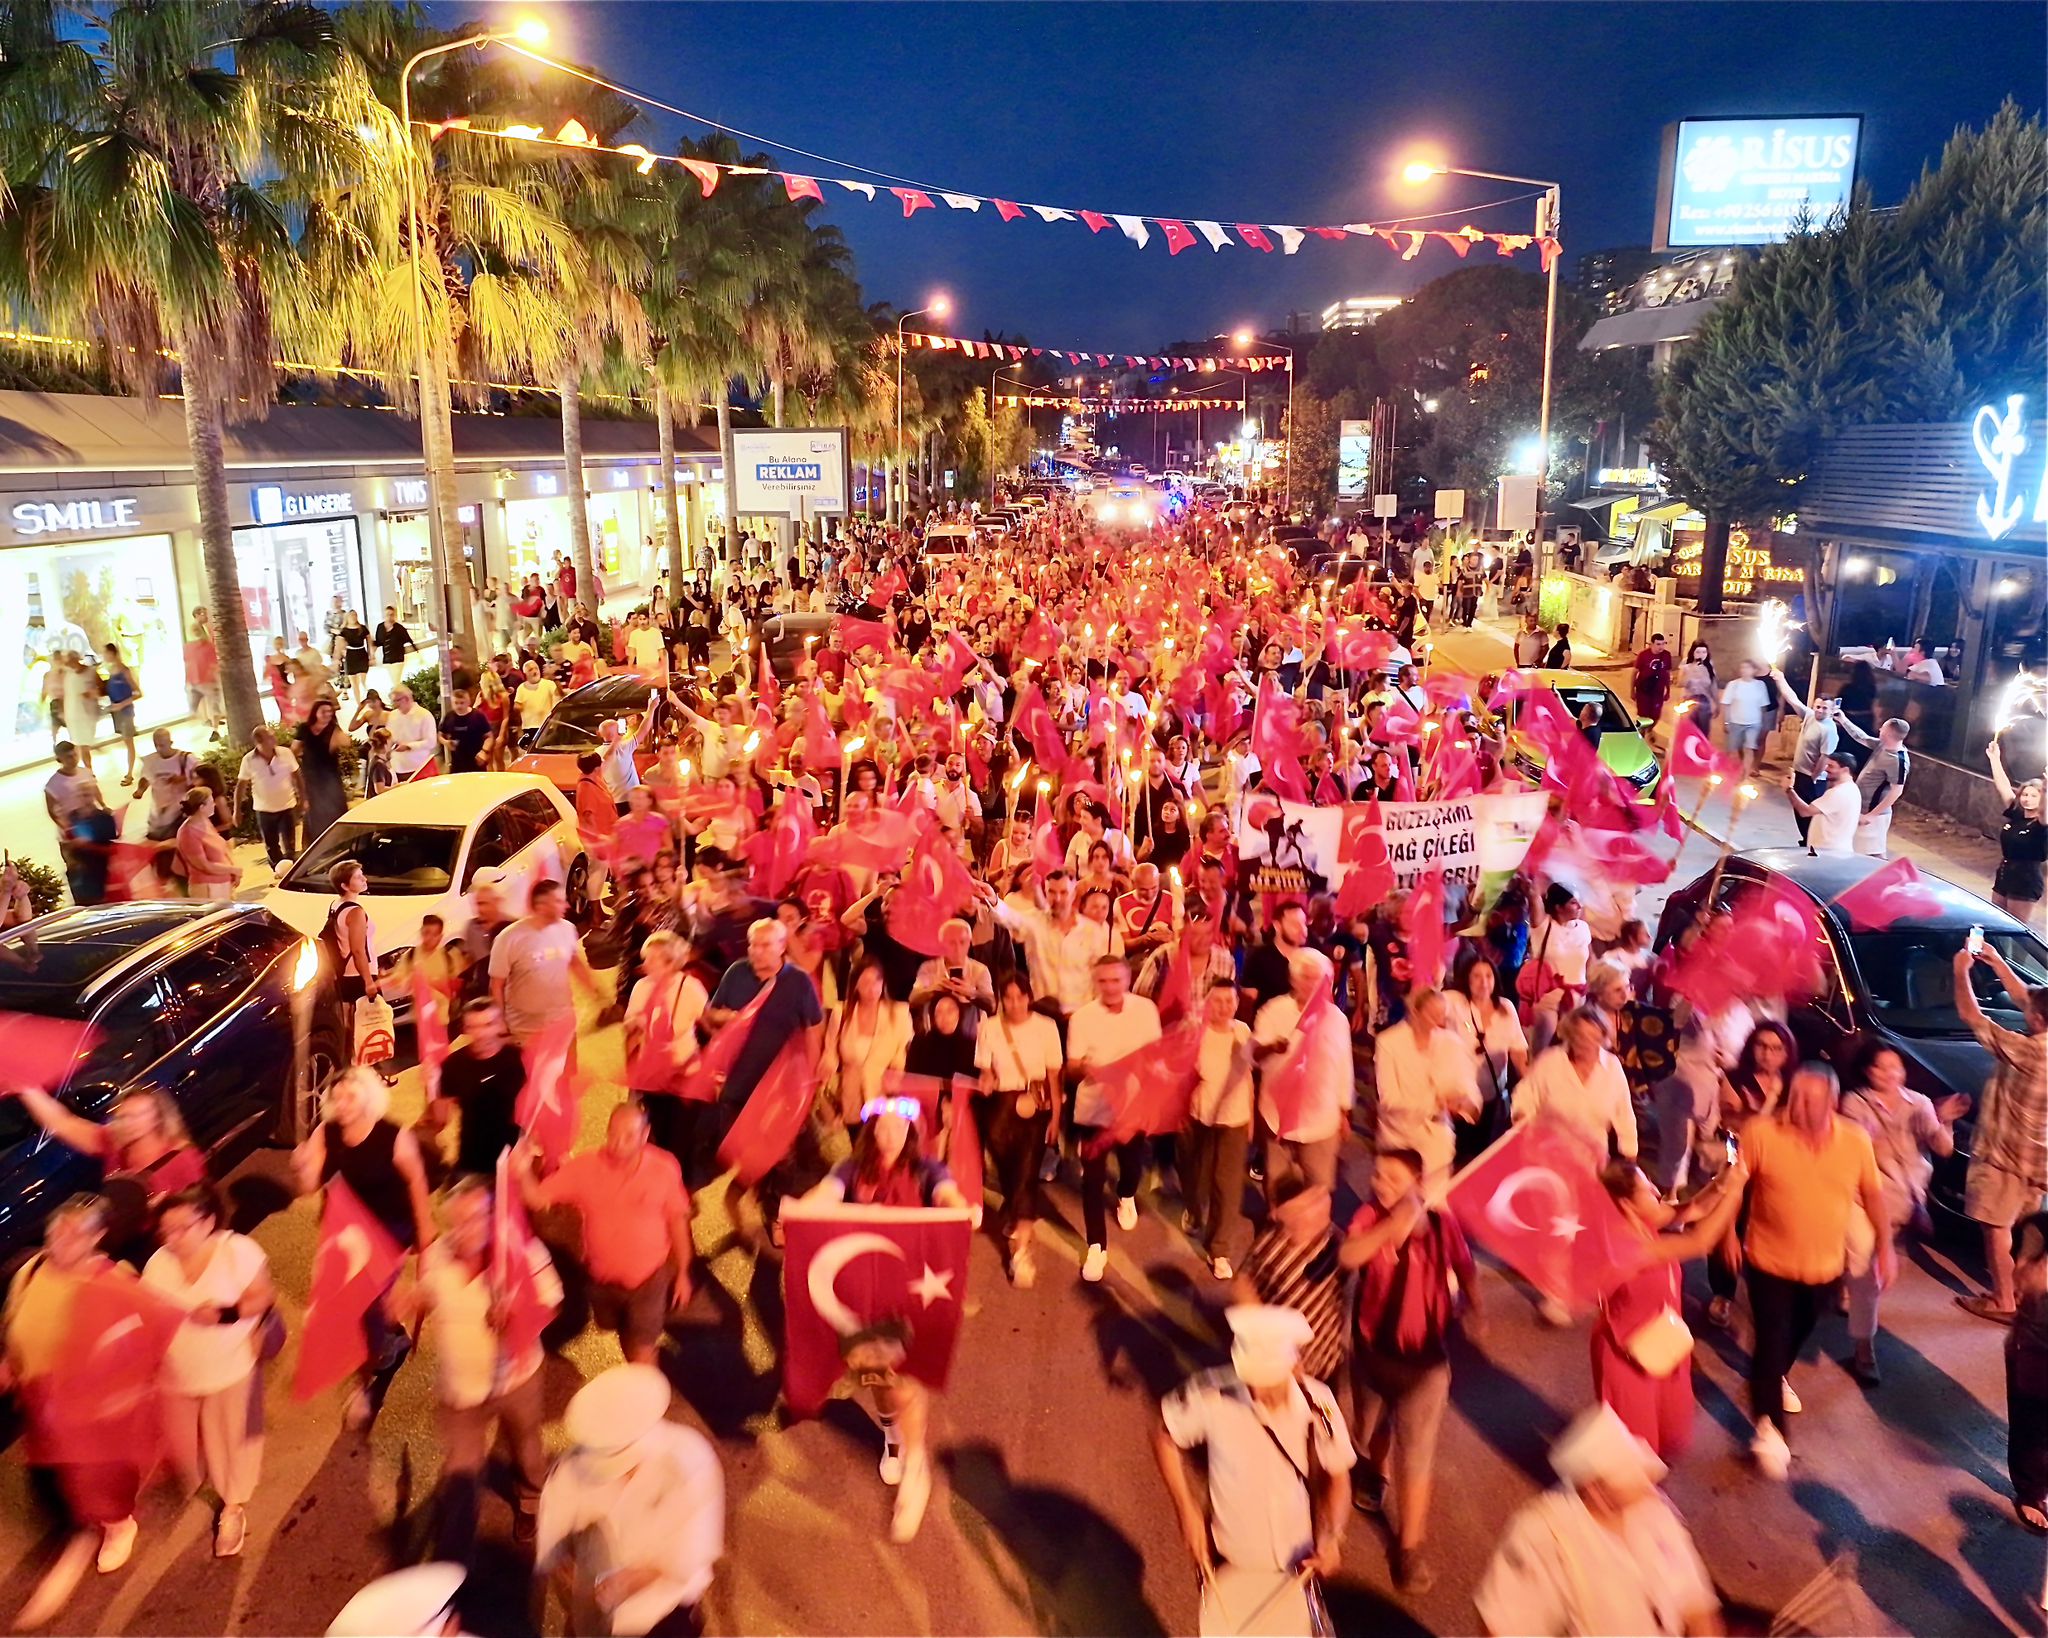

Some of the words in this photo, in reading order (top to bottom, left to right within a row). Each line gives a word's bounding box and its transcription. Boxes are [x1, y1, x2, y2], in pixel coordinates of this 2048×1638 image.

[760, 466, 817, 479] REKLAM
[394, 480, 427, 504] TWIS
[286, 496, 298, 516] G
[298, 493, 353, 515] LINGERIE
[12, 498, 141, 535] SMILE
